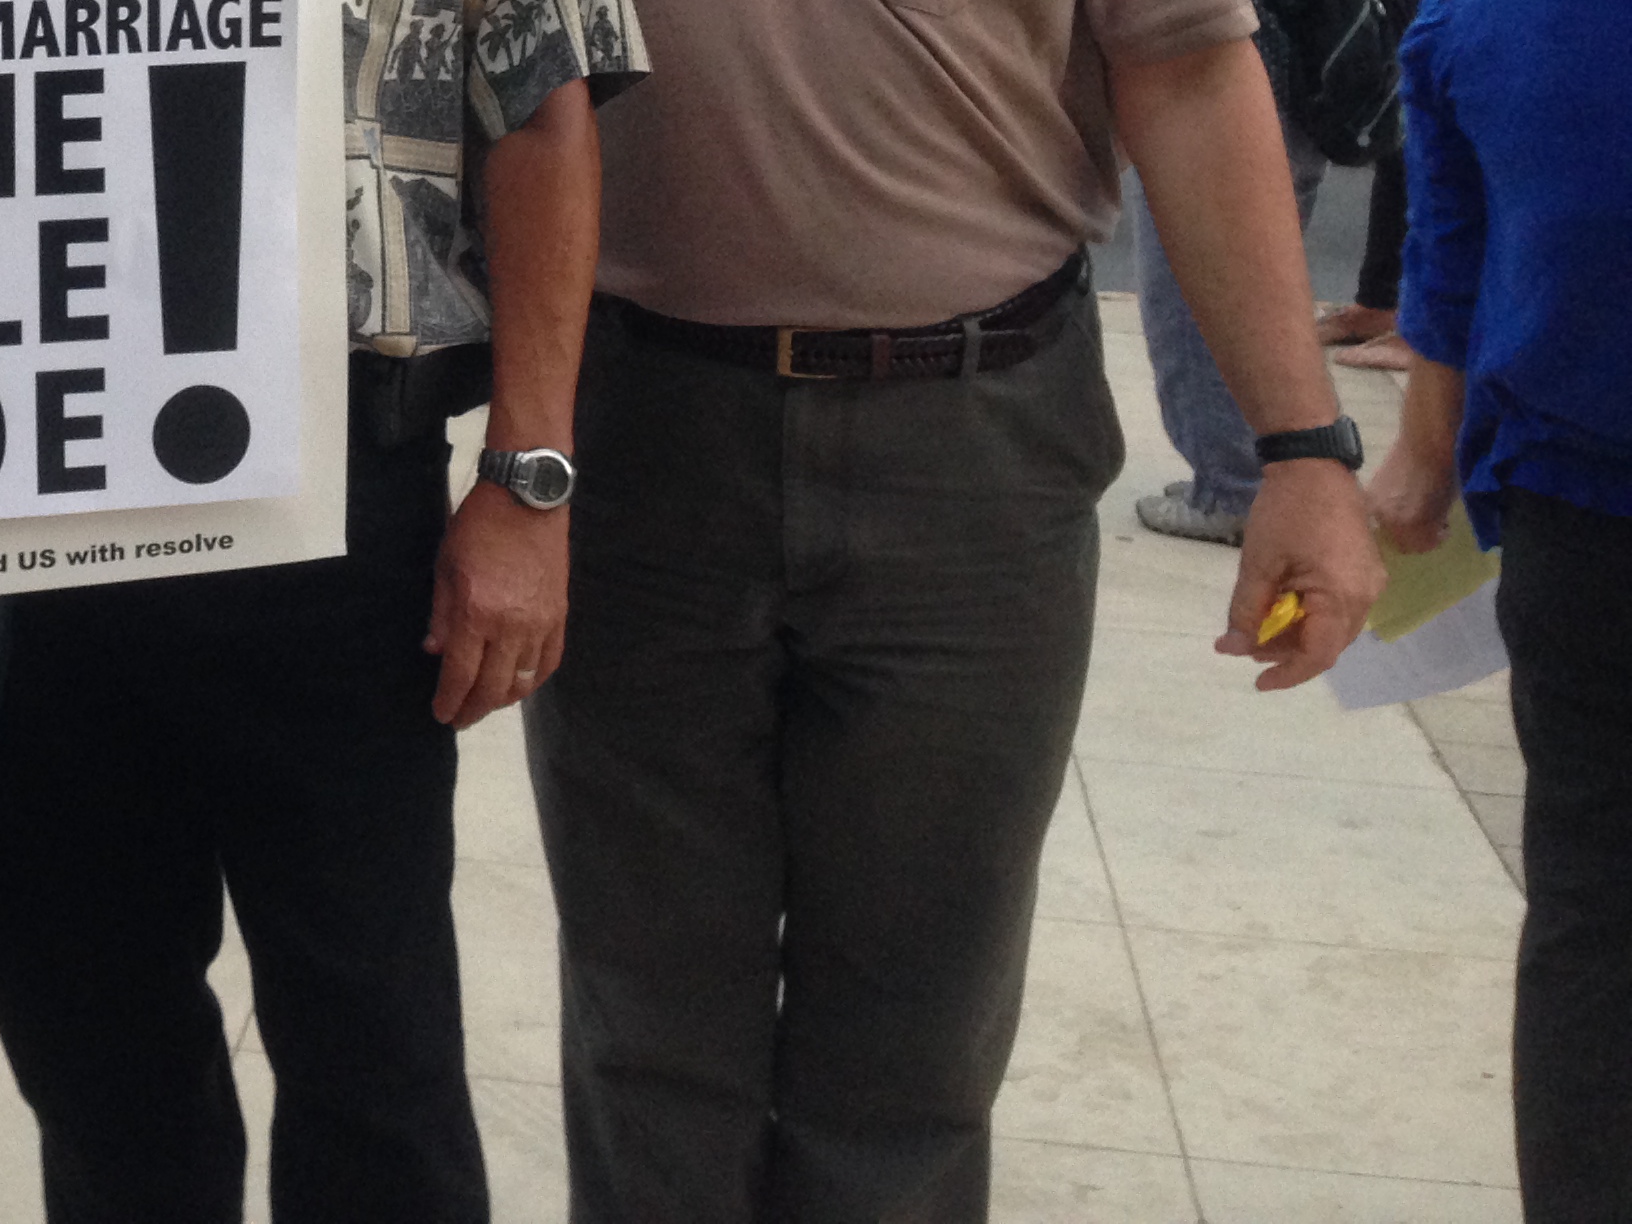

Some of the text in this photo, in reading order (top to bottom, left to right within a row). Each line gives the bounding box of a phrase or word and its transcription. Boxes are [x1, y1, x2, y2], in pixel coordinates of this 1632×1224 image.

[18, 549, 56, 571] US
[66, 543, 125, 566] with
[135, 533, 234, 559] resolve
